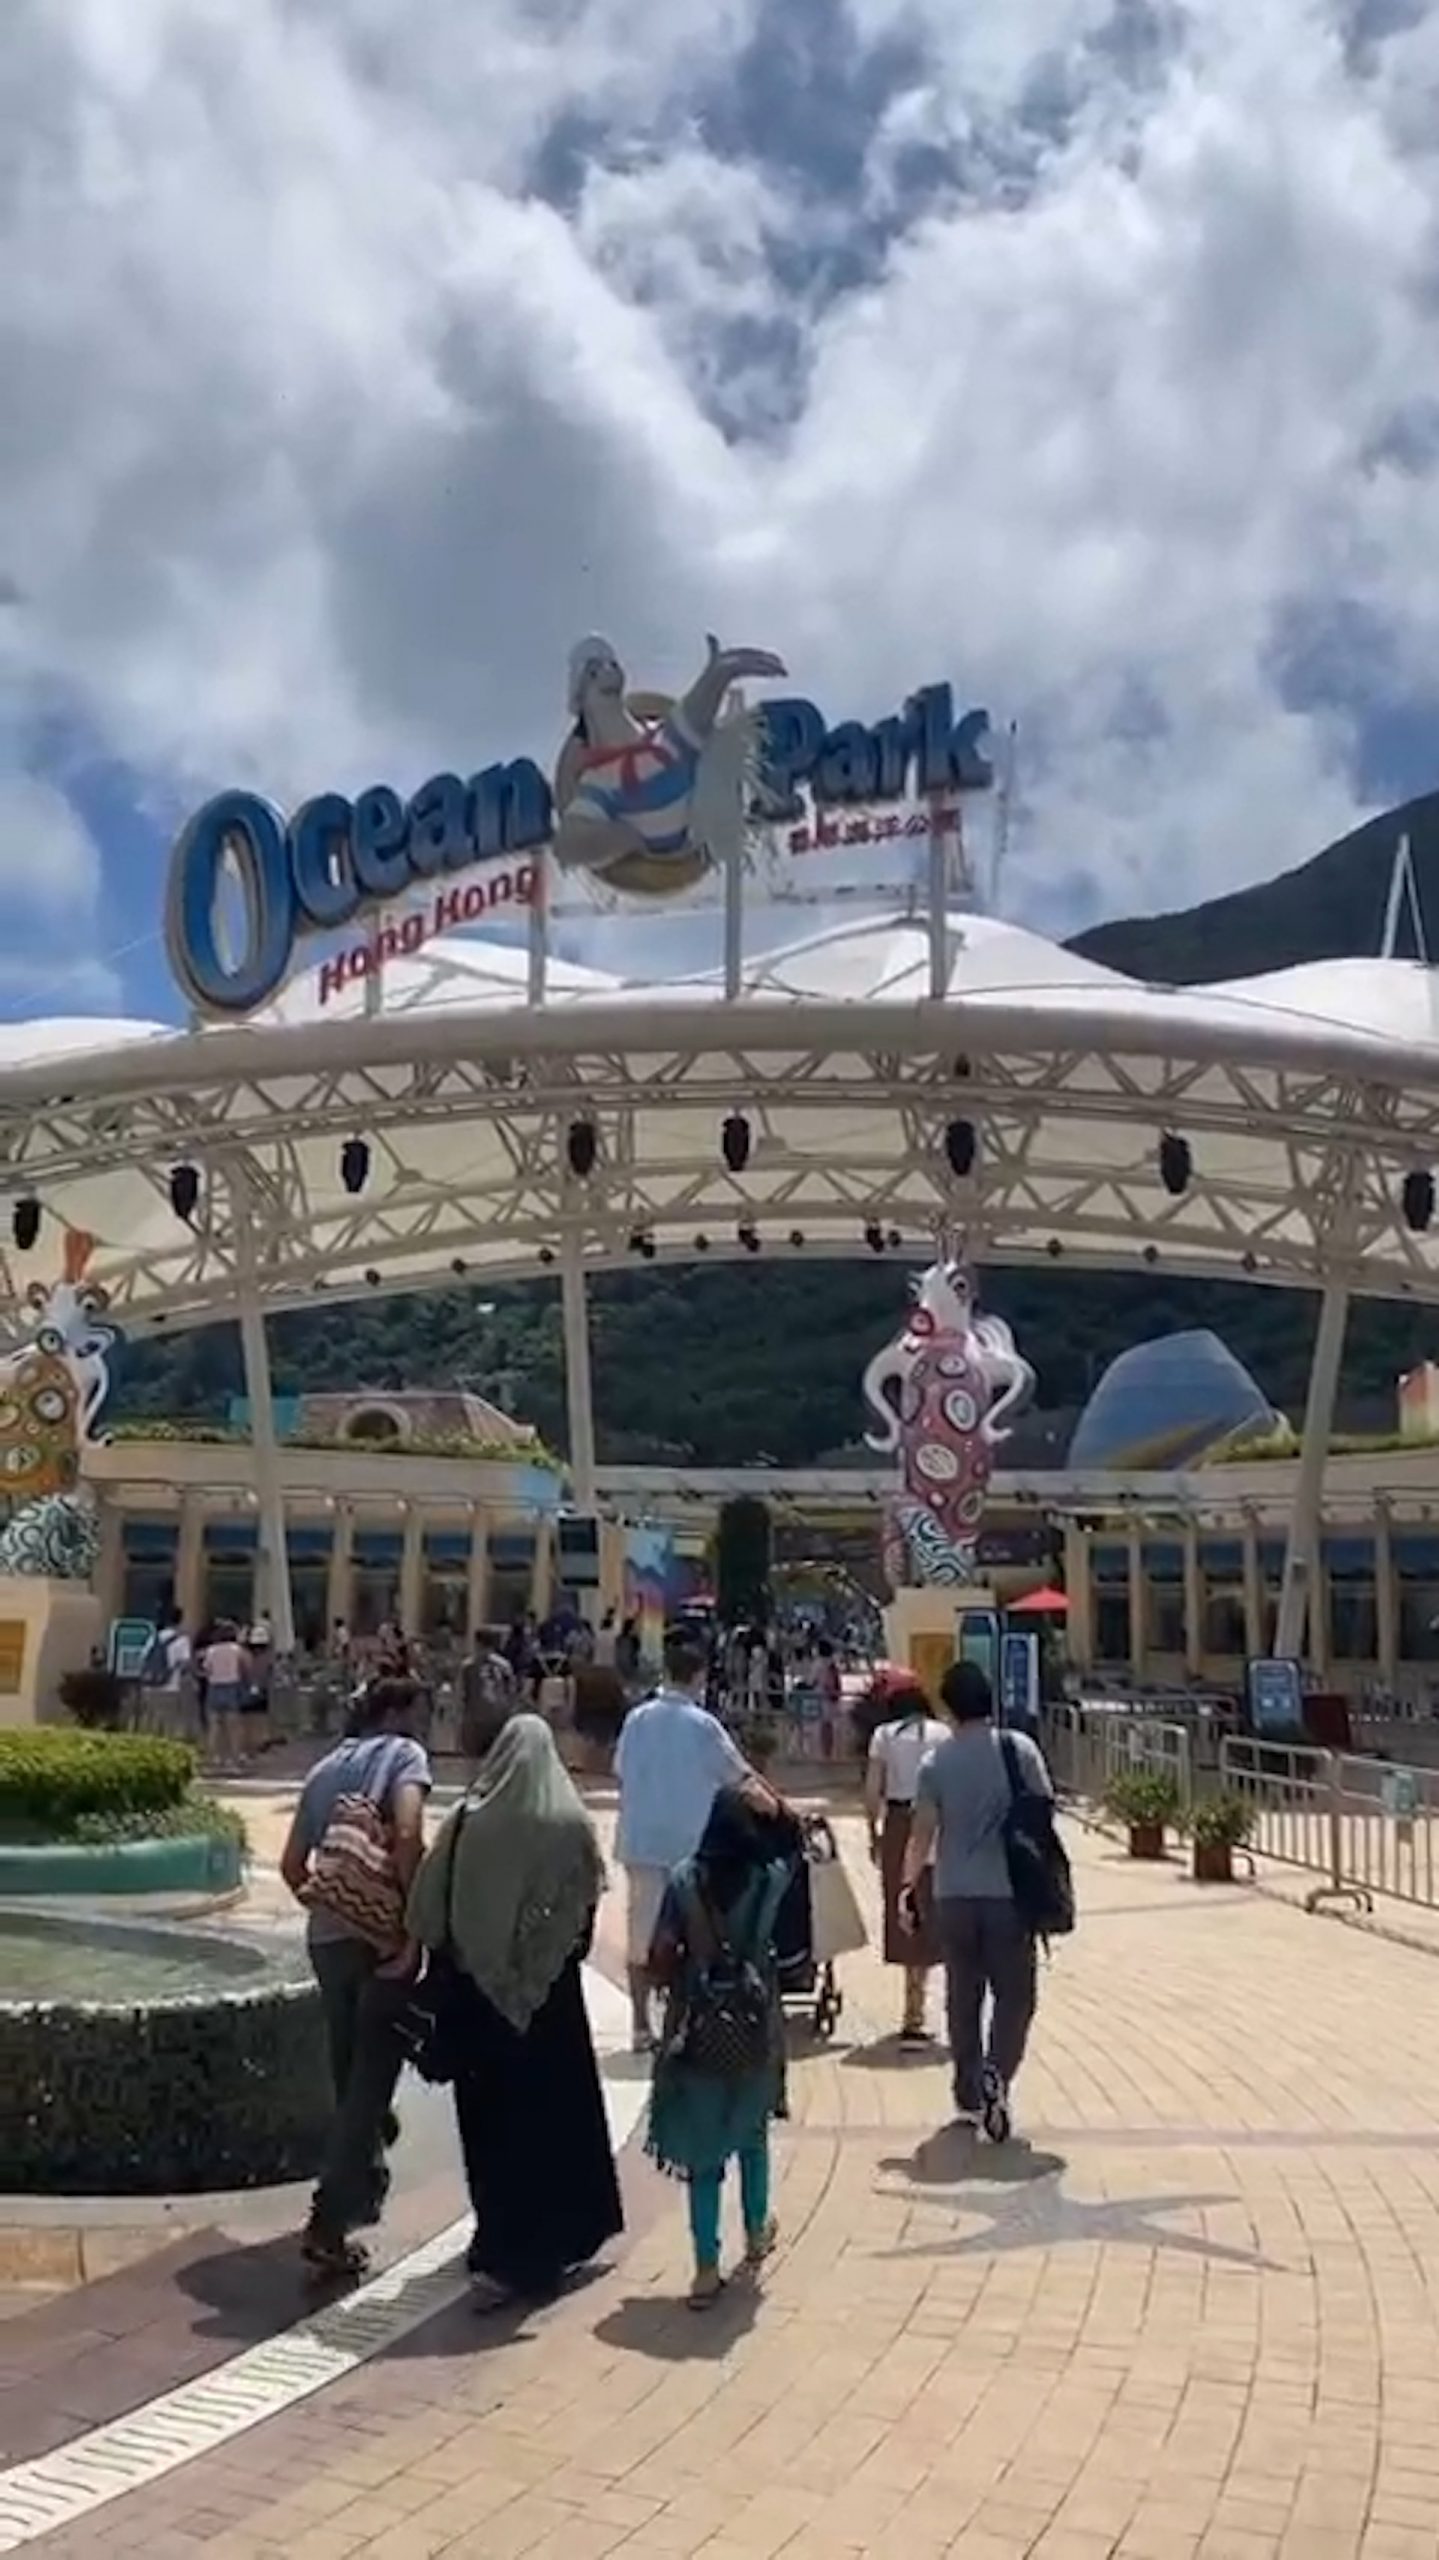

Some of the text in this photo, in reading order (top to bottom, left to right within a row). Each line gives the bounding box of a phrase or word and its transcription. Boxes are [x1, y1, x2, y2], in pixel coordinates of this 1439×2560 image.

[166, 680, 992, 1021] Ocean Park
[319, 865, 539, 1006] Hong Kong
